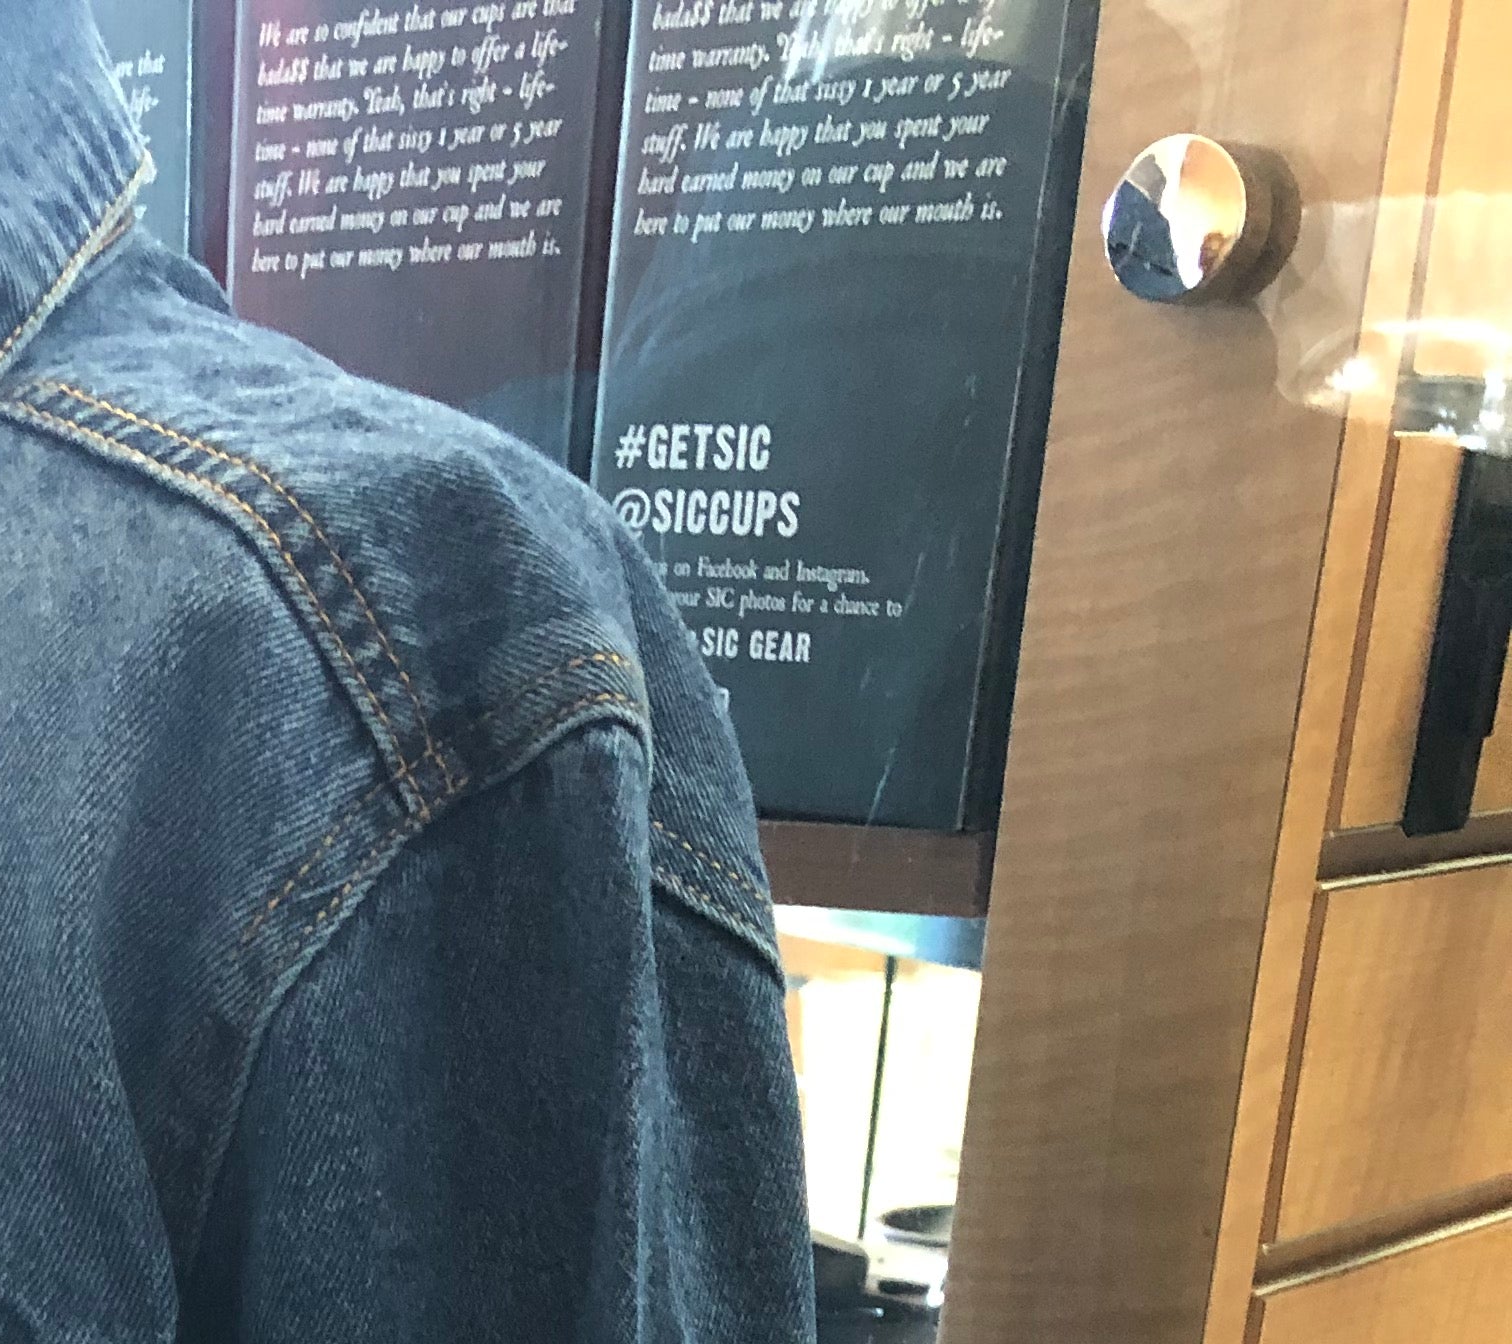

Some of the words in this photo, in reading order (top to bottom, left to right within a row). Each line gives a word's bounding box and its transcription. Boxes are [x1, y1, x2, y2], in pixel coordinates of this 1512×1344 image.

[259, 20, 281, 48] We
[286, 25, 309, 45] are
[315, 23, 330, 43] so
[334, 8, 400, 48] confident
[404, 4, 436, 32] that
[441, 6, 468, 29] our
[472, 3, 505, 33] cups
[512, 1, 537, 22] are
[718, 0, 752, 25] that
[761, 0, 783, 21] we
[314, 54, 343, 81] that
[349, 58, 368, 77] we
[373, 54, 397, 75] are
[403, 44, 445, 80] happy
[451, 46, 466, 67] to
[472, 34, 510, 74] offer
[514, 41, 525, 60] a
[532, 28, 569, 68] life-
[648, 45, 685, 72] time
[692, 42, 770, 71] warranty.
[892, 20, 934, 61] right
[961, 16, 1003, 59] life-
[256, 100, 287, 125] time
[293, 97, 359, 123] warranty.
[364, 85, 405, 116] Yeah,
[413, 80, 455, 110] that's
[461, 75, 496, 115] right
[520, 69, 556, 110] life-
[645, 87, 681, 114] time
[705, 86, 744, 109] none
[749, 75, 774, 115] of
[774, 77, 811, 104] that
[815, 76, 856, 105] sissy
[861, 77, 872, 98] 1
[872, 73, 919, 103] year
[924, 71, 943, 94] or
[947, 71, 963, 101] 5
[964, 67, 1011, 97] year
[255, 137, 286, 162] time
[306, 137, 339, 158] none
[343, 125, 363, 164] of
[363, 124, 394, 154] that
[398, 127, 433, 154] sissy
[438, 127, 447, 147] 1
[448, 125, 485, 151] year
[490, 123, 507, 142] or
[510, 122, 523, 148] 5
[523, 117, 563, 144] year
[642, 123, 688, 164] stuff.
[694, 120, 721, 150] We
[725, 126, 754, 150] are
[759, 118, 809, 157] happy
[814, 114, 852, 144] that
[852, 119, 888, 147] you
[893, 113, 943, 149] spent
[942, 112, 990, 142] your
[254, 170, 293, 208] stuff.
[298, 167, 320, 196] We
[325, 174, 349, 195] are
[352, 165, 395, 201] happy
[399, 161, 431, 188] that
[431, 166, 462, 192] you
[467, 160, 506, 193] spent
[507, 159, 546, 185] your
[638, 165, 678, 195] hard
[681, 161, 739, 193] earned
[741, 168, 795, 194] money
[801, 165, 822, 186] on
[828, 164, 859, 185] our
[864, 160, 895, 193] cup
[901, 150, 940, 181] and
[944, 157, 969, 179] we
[976, 155, 1007, 178] are
[253, 209, 287, 237] hard
[288, 204, 338, 234] earned
[340, 211, 385, 234] money
[390, 209, 408, 227] on
[413, 207, 439, 225] our
[442, 204, 470, 233] cup
[474, 194, 506, 223] and
[509, 200, 532, 218] we
[535, 198, 563, 217] are
[634, 208, 668, 236] here
[674, 212, 690, 234] to
[691, 211, 722, 244] put
[727, 211, 757, 232] our
[761, 208, 815, 233] money
[822, 197, 873, 227] where
[879, 203, 910, 223] our
[915, 192, 974, 223] mouth
[981, 192, 1003, 221] is.
[251, 247, 281, 273] here
[285, 251, 299, 272] to
[300, 250, 325, 280] put
[329, 250, 354, 269] our
[358, 247, 404, 272] money
[409, 235, 452, 264] where
[456, 242, 484, 261] our
[487, 229, 537, 260] mouth
[542, 231, 561, 255] is.
[614, 423, 772, 472] #GETSIC
[613, 489, 801, 538] @SICCUPS
[673, 561, 691, 577] on
[698, 555, 757, 580] Facebook
[763, 559, 790, 581] and
[705, 587, 735, 609] SIC
[739, 589, 787, 619] photos
[792, 590, 815, 613] for
[819, 598, 829, 614] a
[833, 592, 879, 617] chance
[886, 599, 903, 618] to
[701, 626, 740, 659] SIC
[749, 629, 811, 663] GEAR
